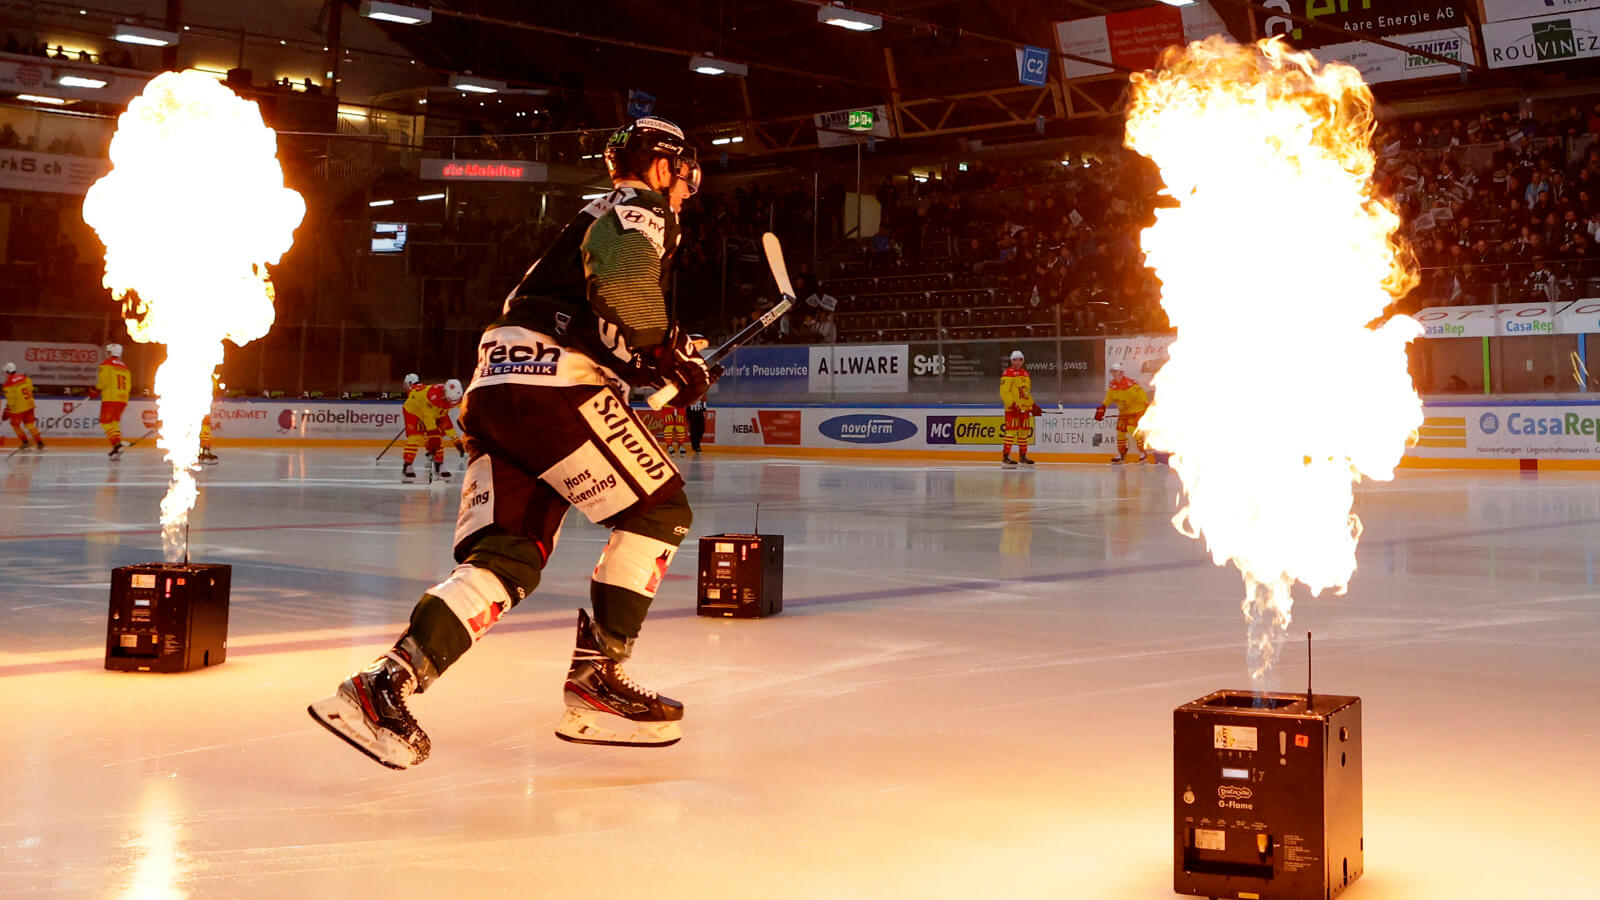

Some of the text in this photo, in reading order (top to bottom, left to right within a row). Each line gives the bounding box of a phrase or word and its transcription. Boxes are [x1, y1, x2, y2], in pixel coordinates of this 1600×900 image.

[1344, 7, 1455, 31] Aare Energie AG
[1493, 35, 1600, 62] ROUVINEZ
[1026, 58, 1044, 75] C2
[1425, 323, 1465, 336] asaRep
[1506, 320, 1554, 335] CasaRep
[26, 349, 98, 362] SWISSLOS
[752, 365, 808, 377] Pneuservice
[818, 356, 899, 375] ALWARE
[913, 354, 946, 375] S+B
[301, 410, 400, 427] möbelberger
[1042, 418, 1058, 429] IHR
[733, 424, 754, 434] NEBA
[841, 419, 893, 438] novoferm
[930, 423, 951, 438] MC
[956, 422, 995, 438] Office
[593, 395, 665, 481] Schwob
[1042, 433, 1052, 443] IN
[563, 468, 592, 490] Hans
[1218, 799, 1253, 810] G-Flame
